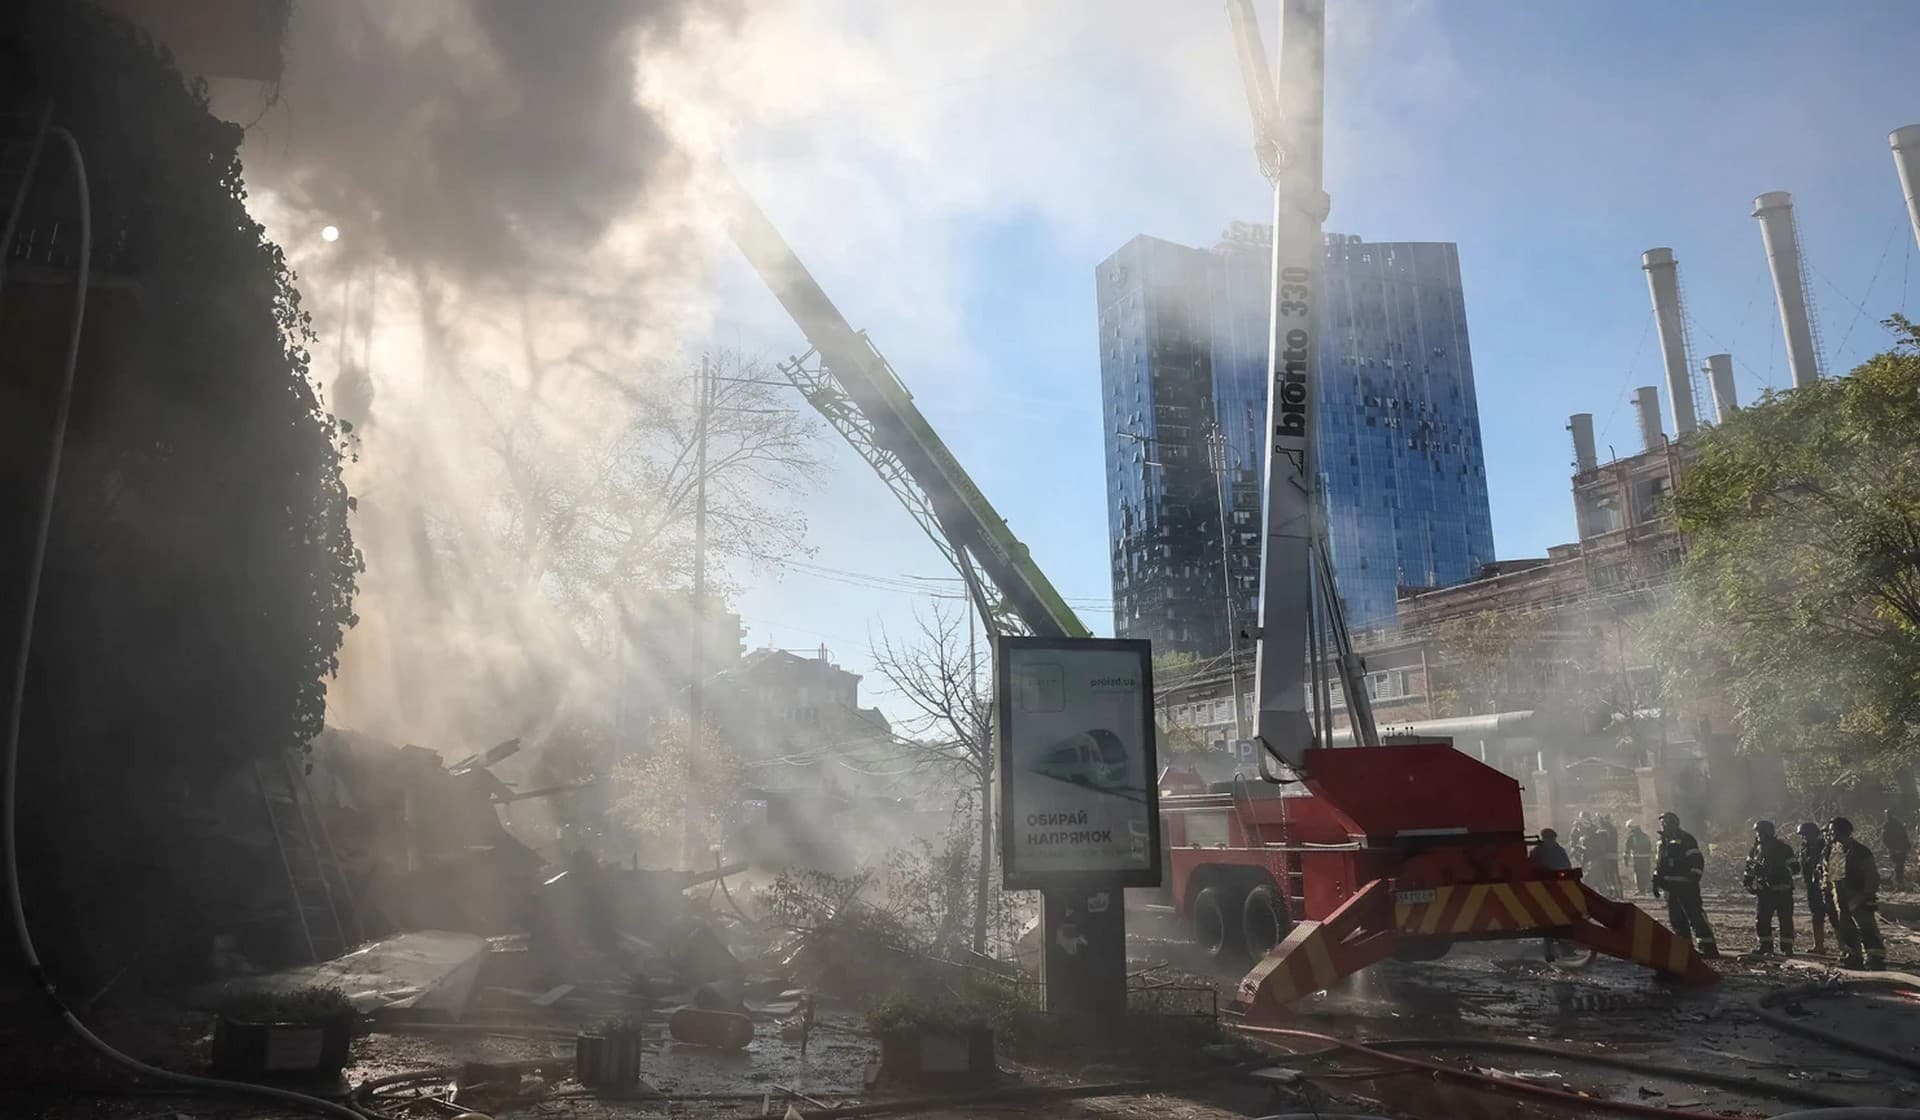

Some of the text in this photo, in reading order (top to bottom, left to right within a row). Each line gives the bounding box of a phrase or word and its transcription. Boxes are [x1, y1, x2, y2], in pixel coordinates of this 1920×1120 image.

[1276, 266, 1309, 438] bronto 330
[1240, 743, 1253, 762] P
[1026, 810, 1089, 827] ОБИРАЙ
[1027, 831, 1113, 846] НАПРЯМОК
